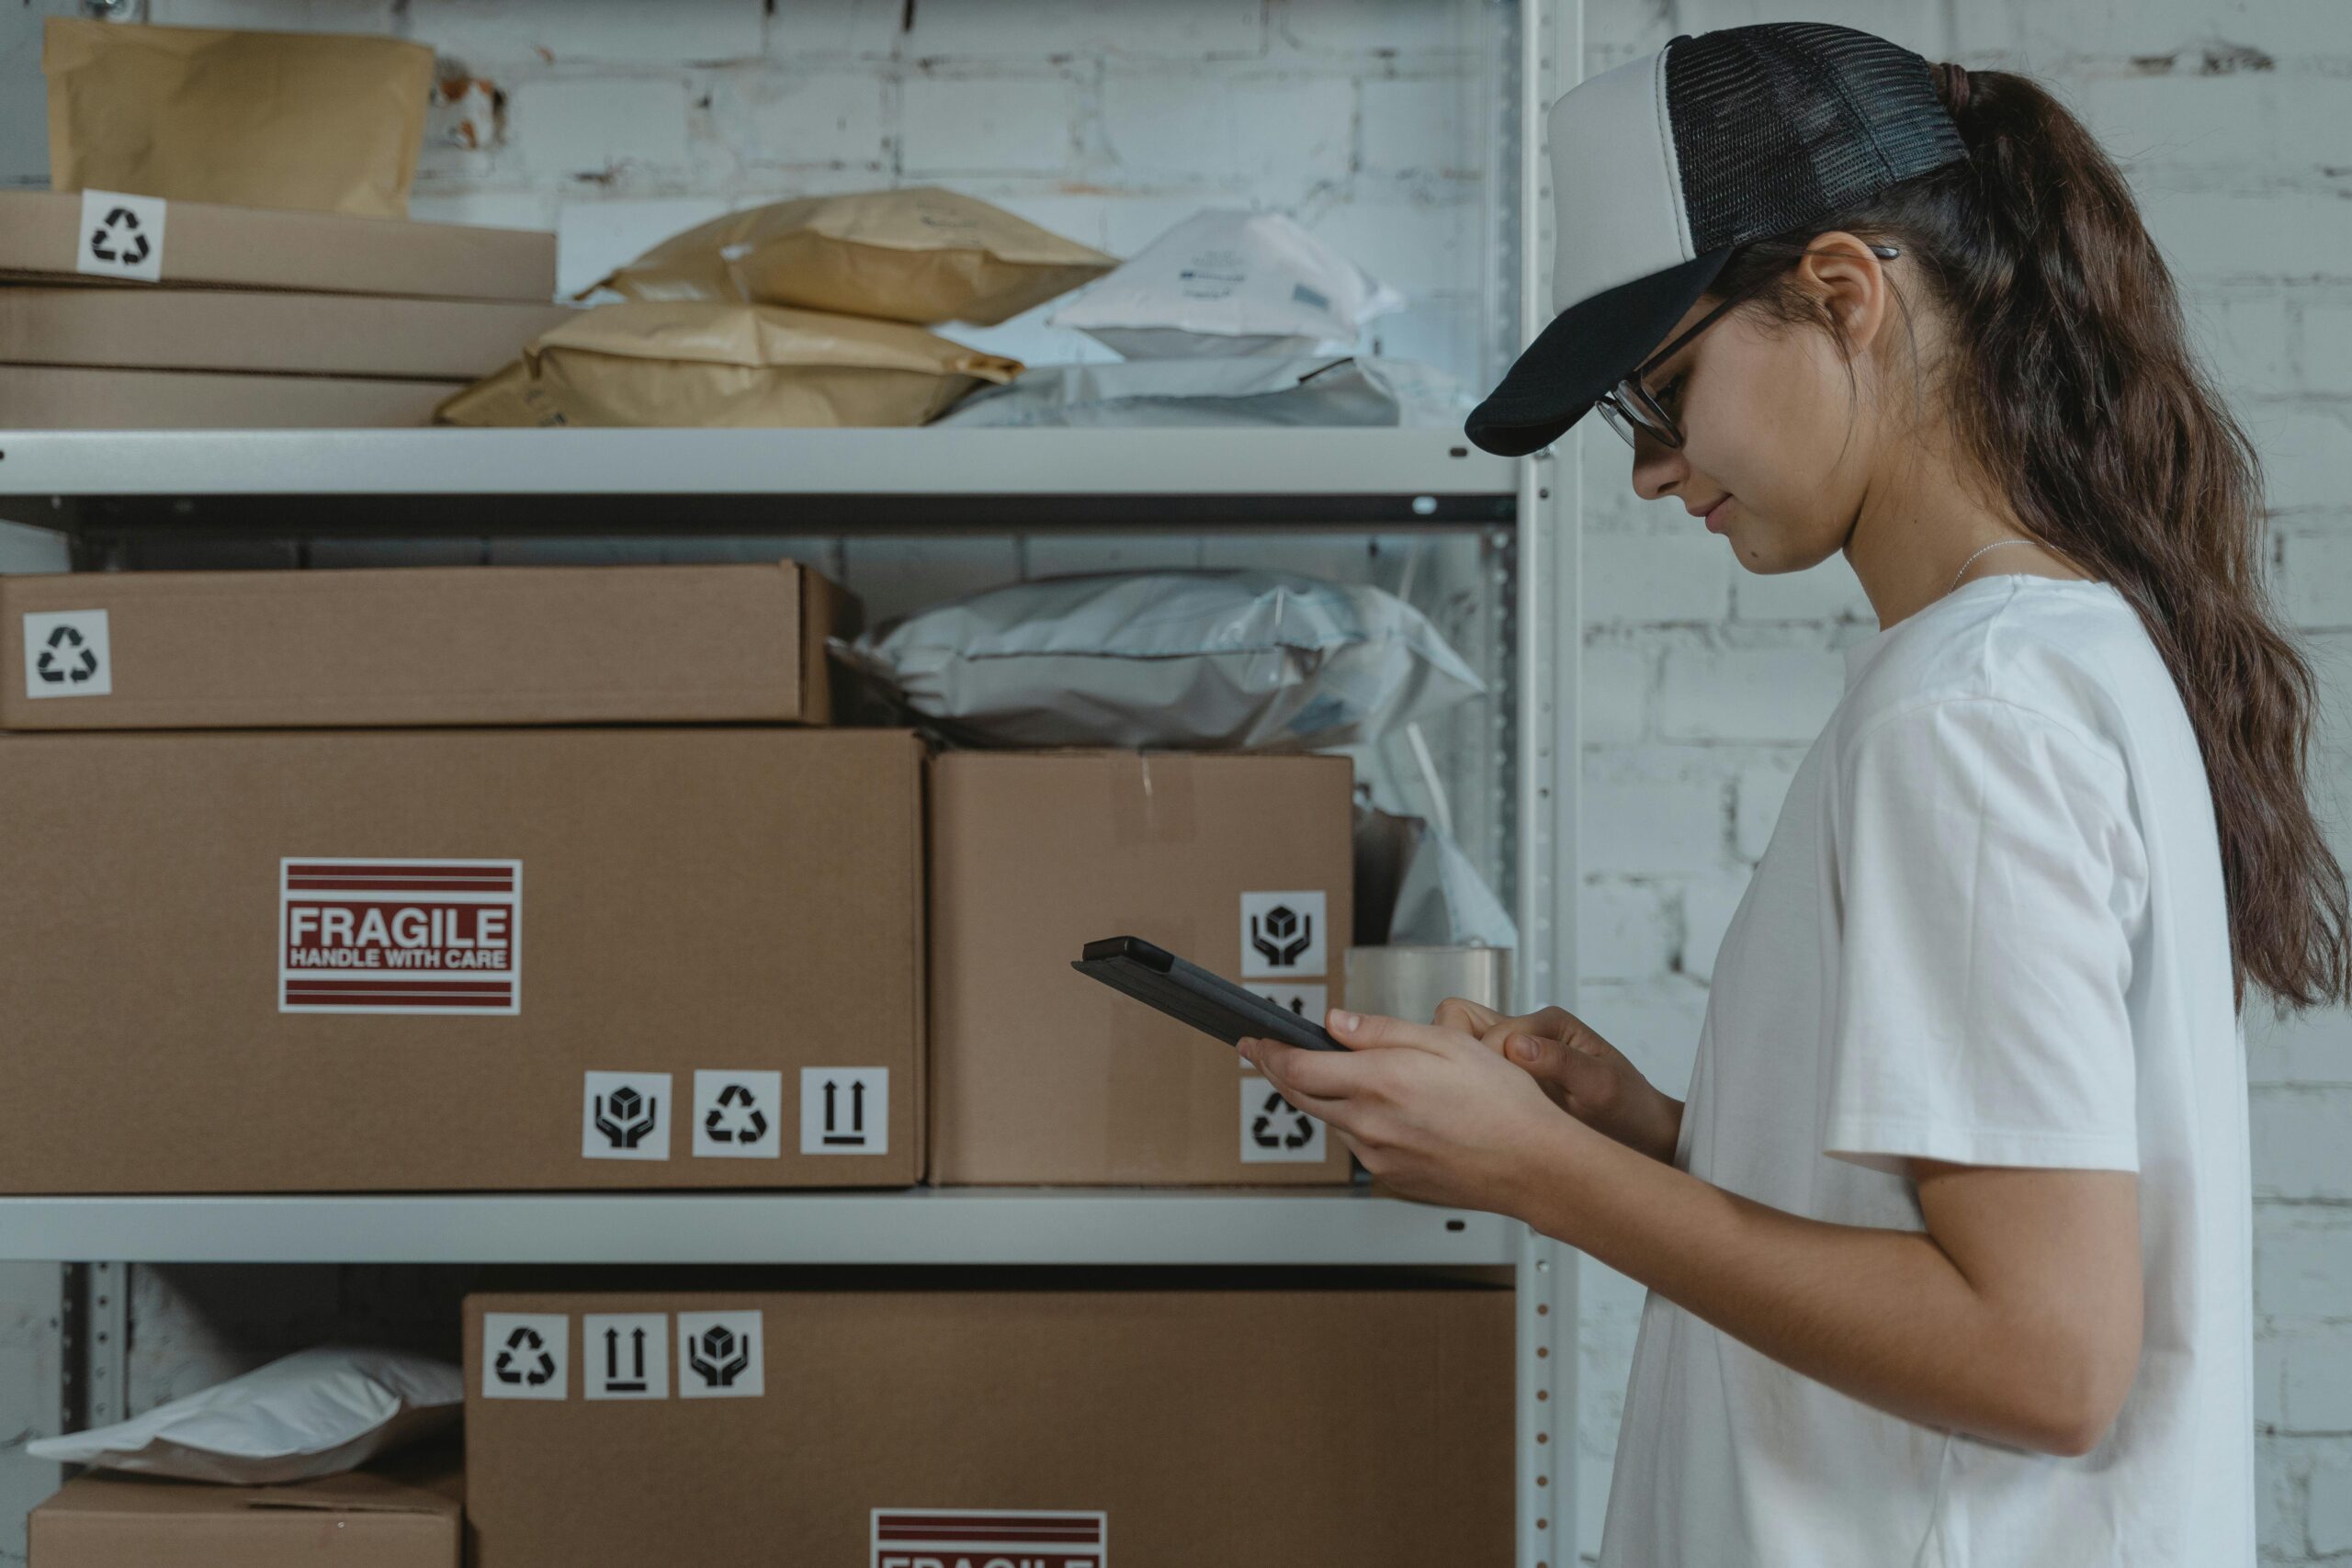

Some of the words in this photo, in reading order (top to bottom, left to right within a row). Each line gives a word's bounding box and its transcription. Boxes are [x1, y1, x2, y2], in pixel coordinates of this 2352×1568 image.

[289, 907, 508, 949] FRAGILE
[289, 948, 381, 967] HANDLE
[384, 949, 441, 968] WITH
[444, 949, 507, 969] CARE
